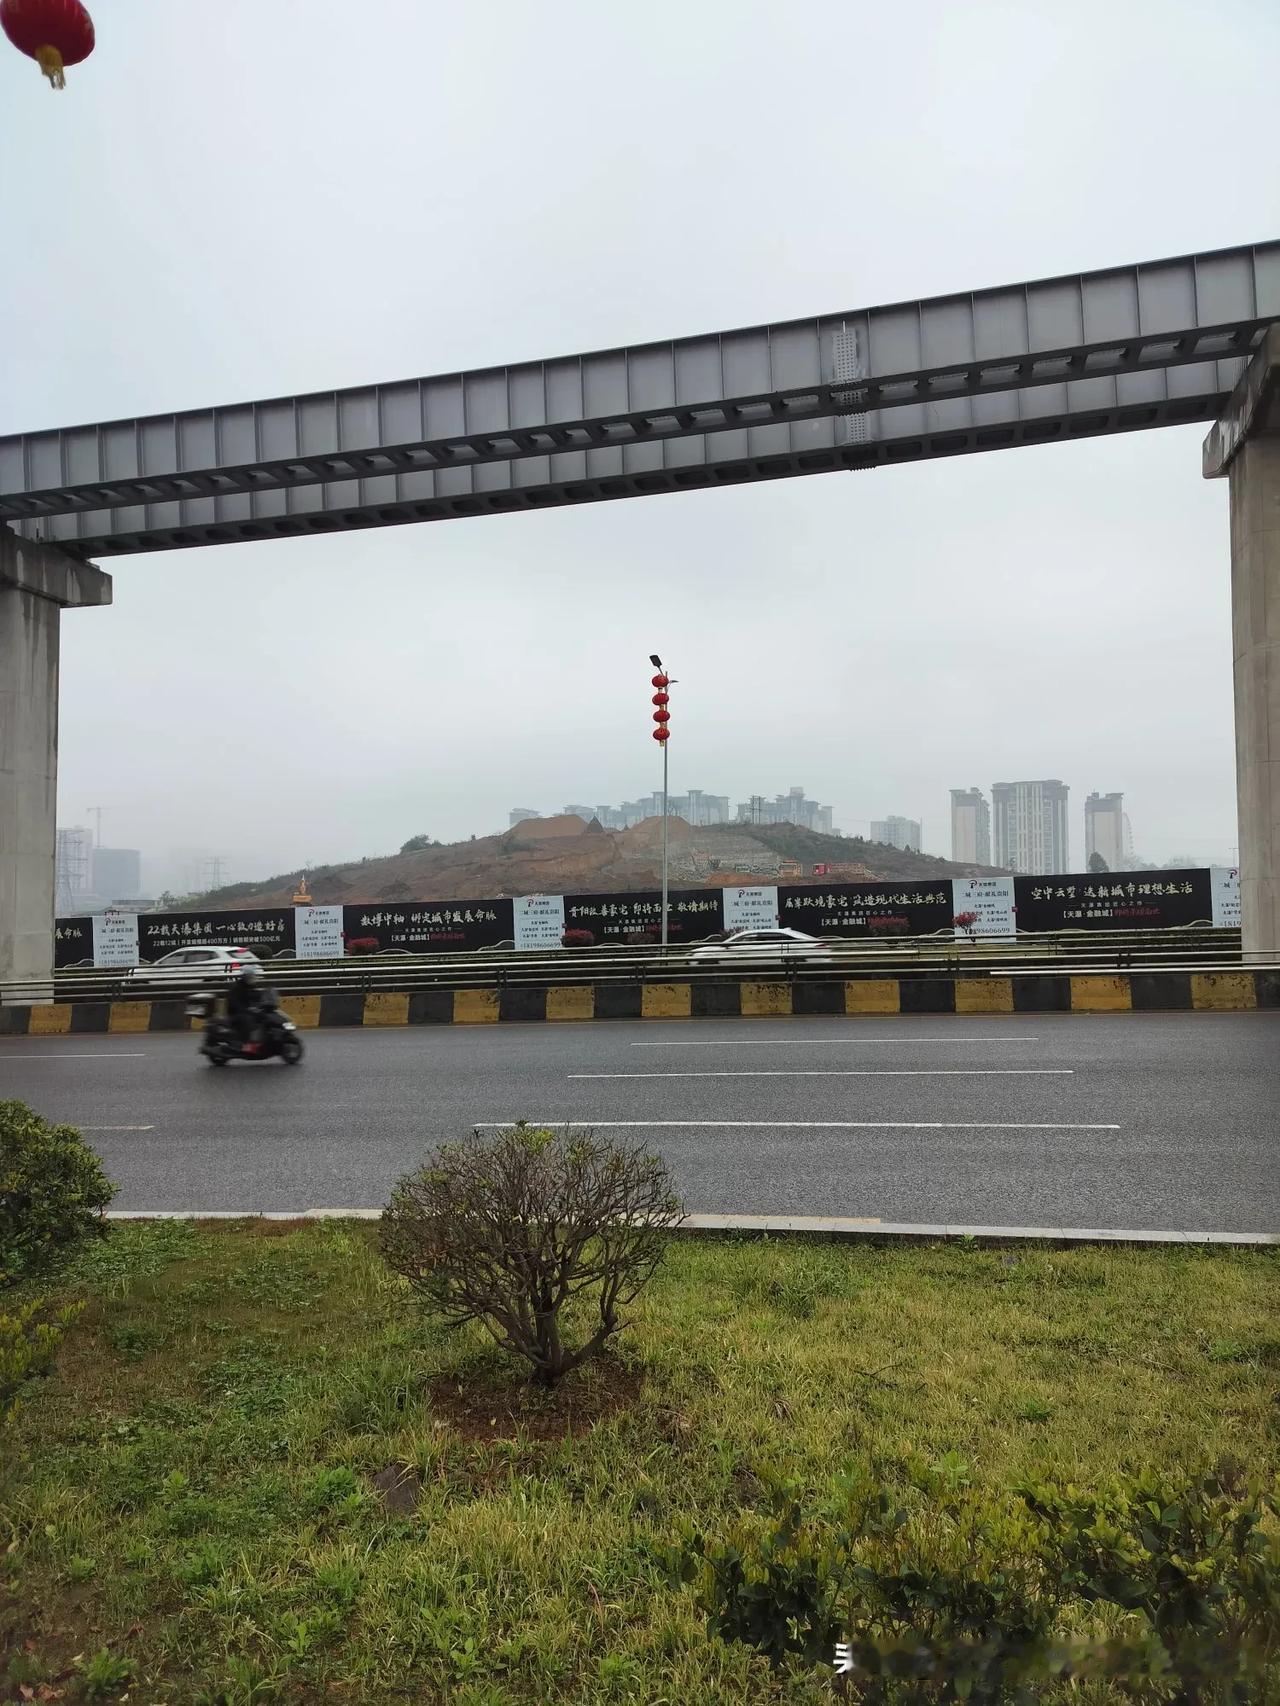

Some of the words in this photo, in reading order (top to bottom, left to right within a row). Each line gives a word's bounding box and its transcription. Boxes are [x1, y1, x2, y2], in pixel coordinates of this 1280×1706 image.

[852, 892, 947, 907] 筑造现代生活典范
[1031, 885, 1076, 900] 空中云墅
[569, 903, 628, 918] 贵阳改善豪宅
[677, 900, 718, 912] 敬请期待
[360, 912, 405, 927] 数博中轴
[411, 909, 497, 924] 绑定城市发展命脉
